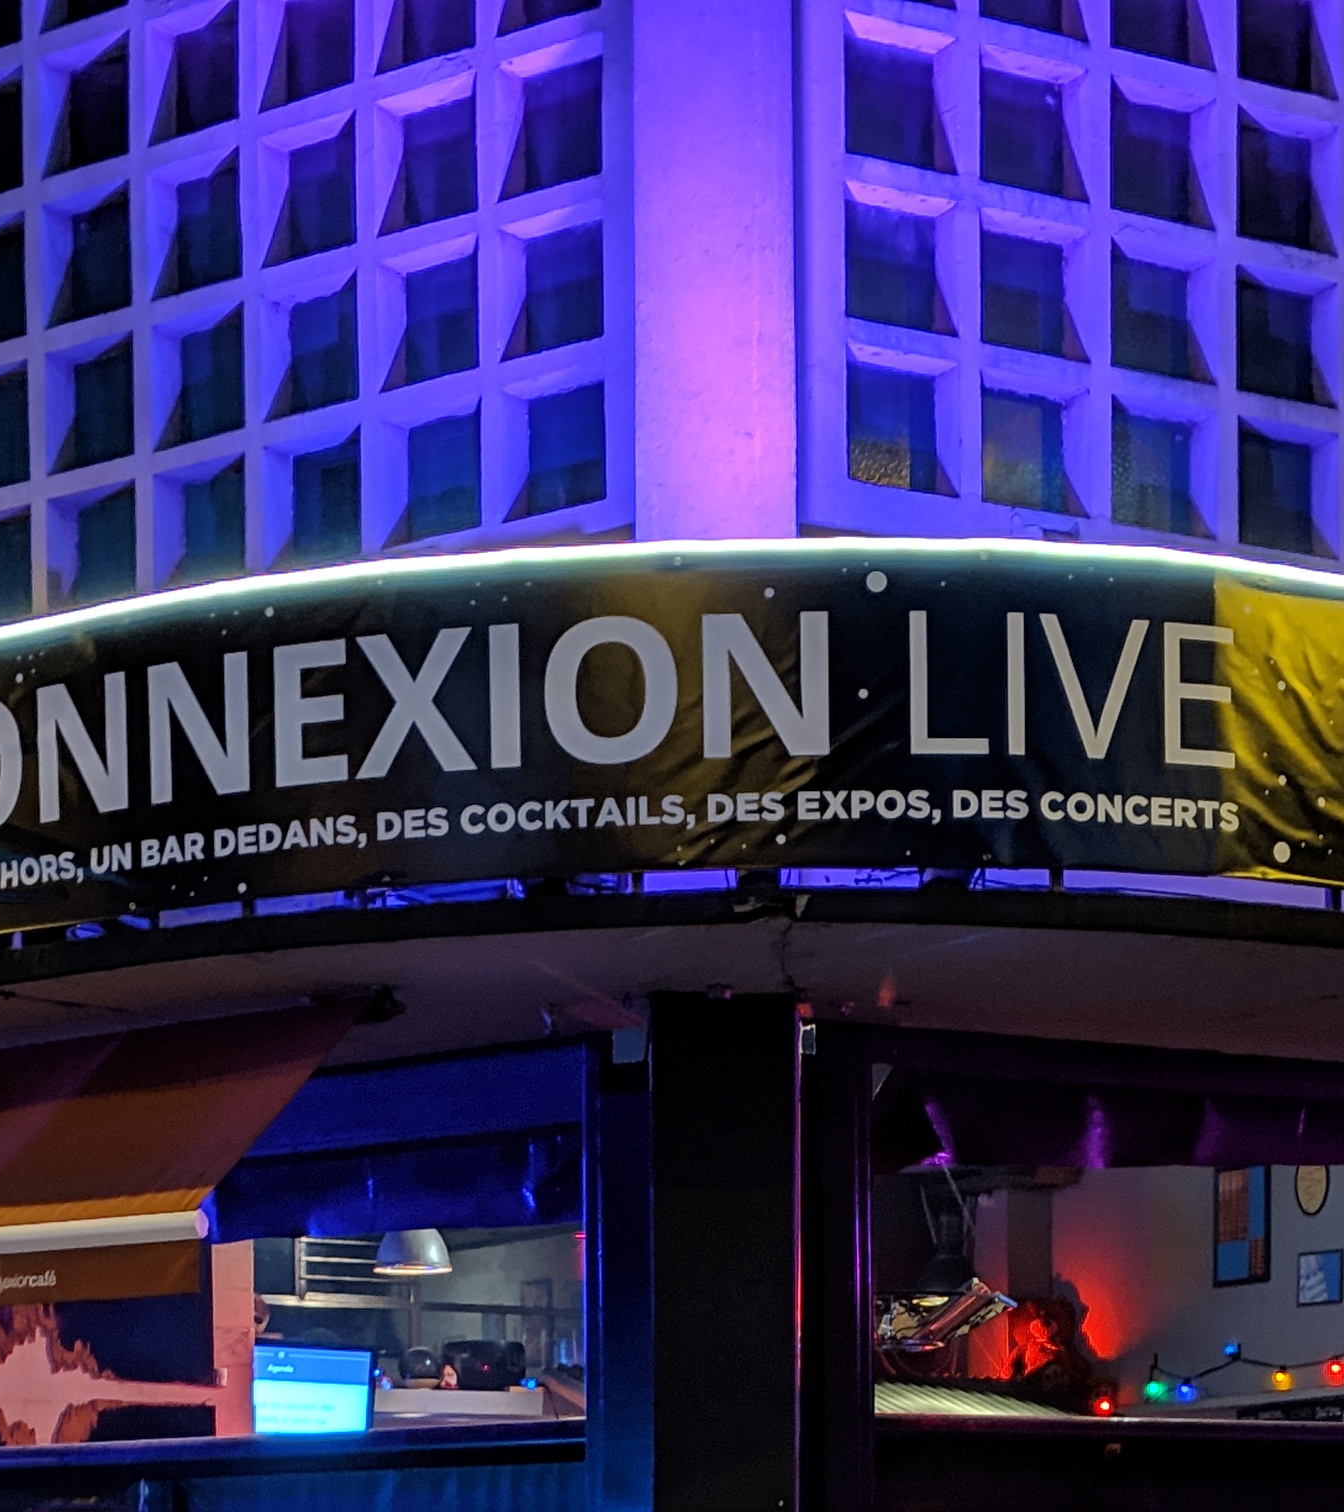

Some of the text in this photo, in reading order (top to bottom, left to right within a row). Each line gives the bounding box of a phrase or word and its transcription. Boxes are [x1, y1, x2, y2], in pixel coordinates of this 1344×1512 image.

[908, 610, 1236, 769] LIVE
[89, 840, 133, 874] UN
[141, 830, 205, 868] BAR
[213, 814, 368, 859] DEDANS,
[375, 808, 449, 842] DES
[459, 794, 696, 834] COCKTAILS,
[707, 792, 786, 824] DES
[796, 789, 942, 825] EXPOS,
[952, 789, 1030, 821] DES
[1040, 791, 1241, 832] CONCERTS
